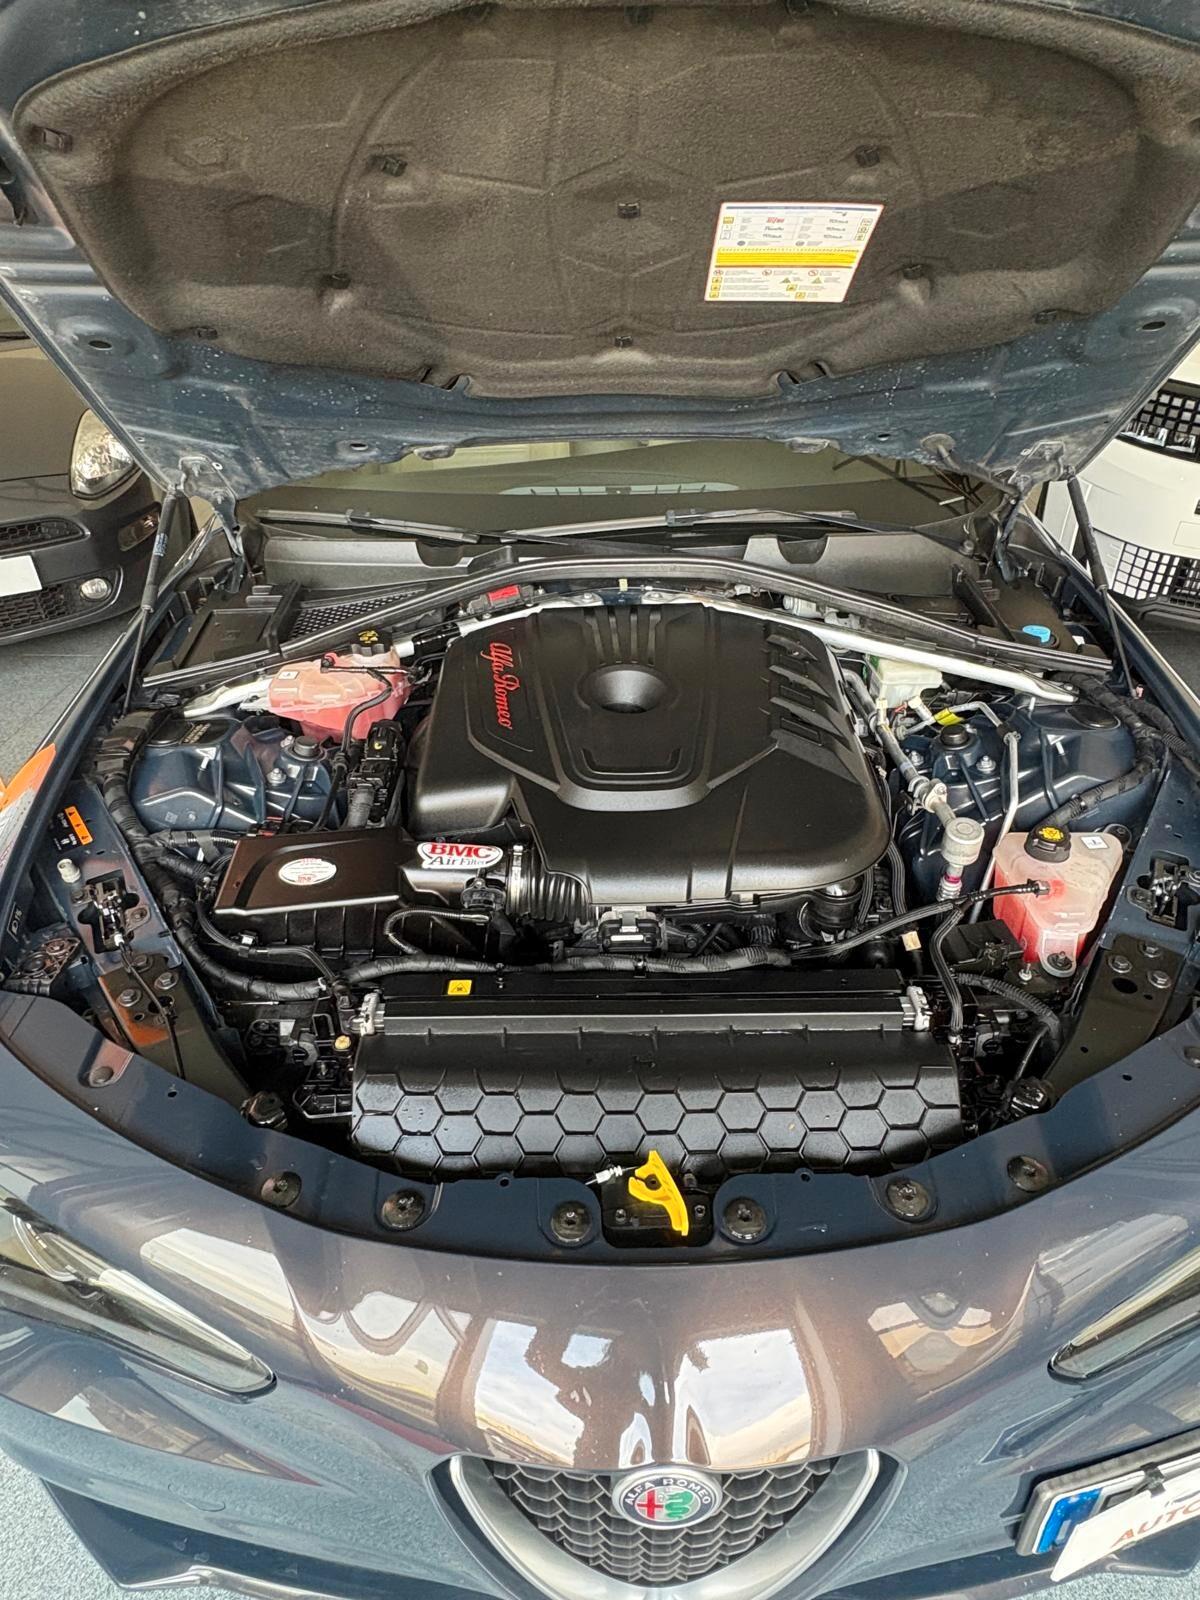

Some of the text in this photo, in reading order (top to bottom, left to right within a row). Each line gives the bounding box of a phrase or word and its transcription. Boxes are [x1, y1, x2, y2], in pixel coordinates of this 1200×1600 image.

[480, 643, 520, 729] Alfa Romeo
[428, 843, 493, 859] BMC
[428, 856, 459, 865] Air
[624, 1478, 711, 1506] ALFA ROMEO
